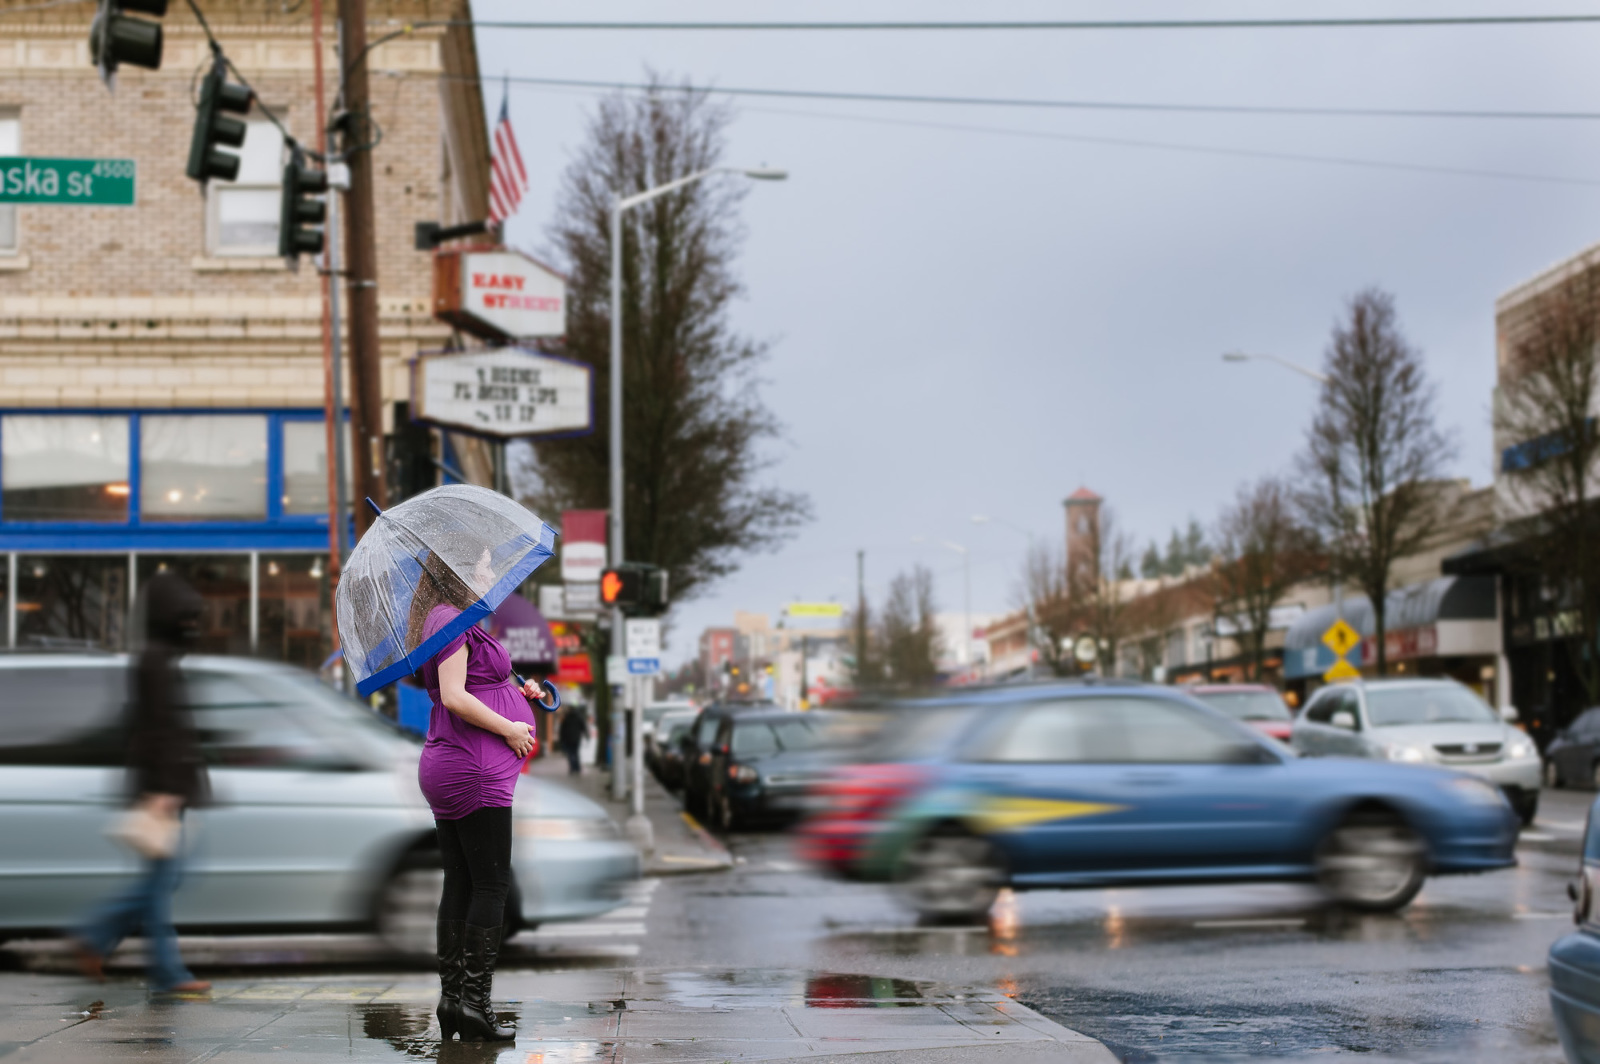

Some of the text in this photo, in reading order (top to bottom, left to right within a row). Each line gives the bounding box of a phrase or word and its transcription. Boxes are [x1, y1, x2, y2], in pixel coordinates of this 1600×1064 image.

[92, 161, 133, 178] 4500
[472, 273, 526, 291] EASY
[483, 293, 561, 312] STREET
